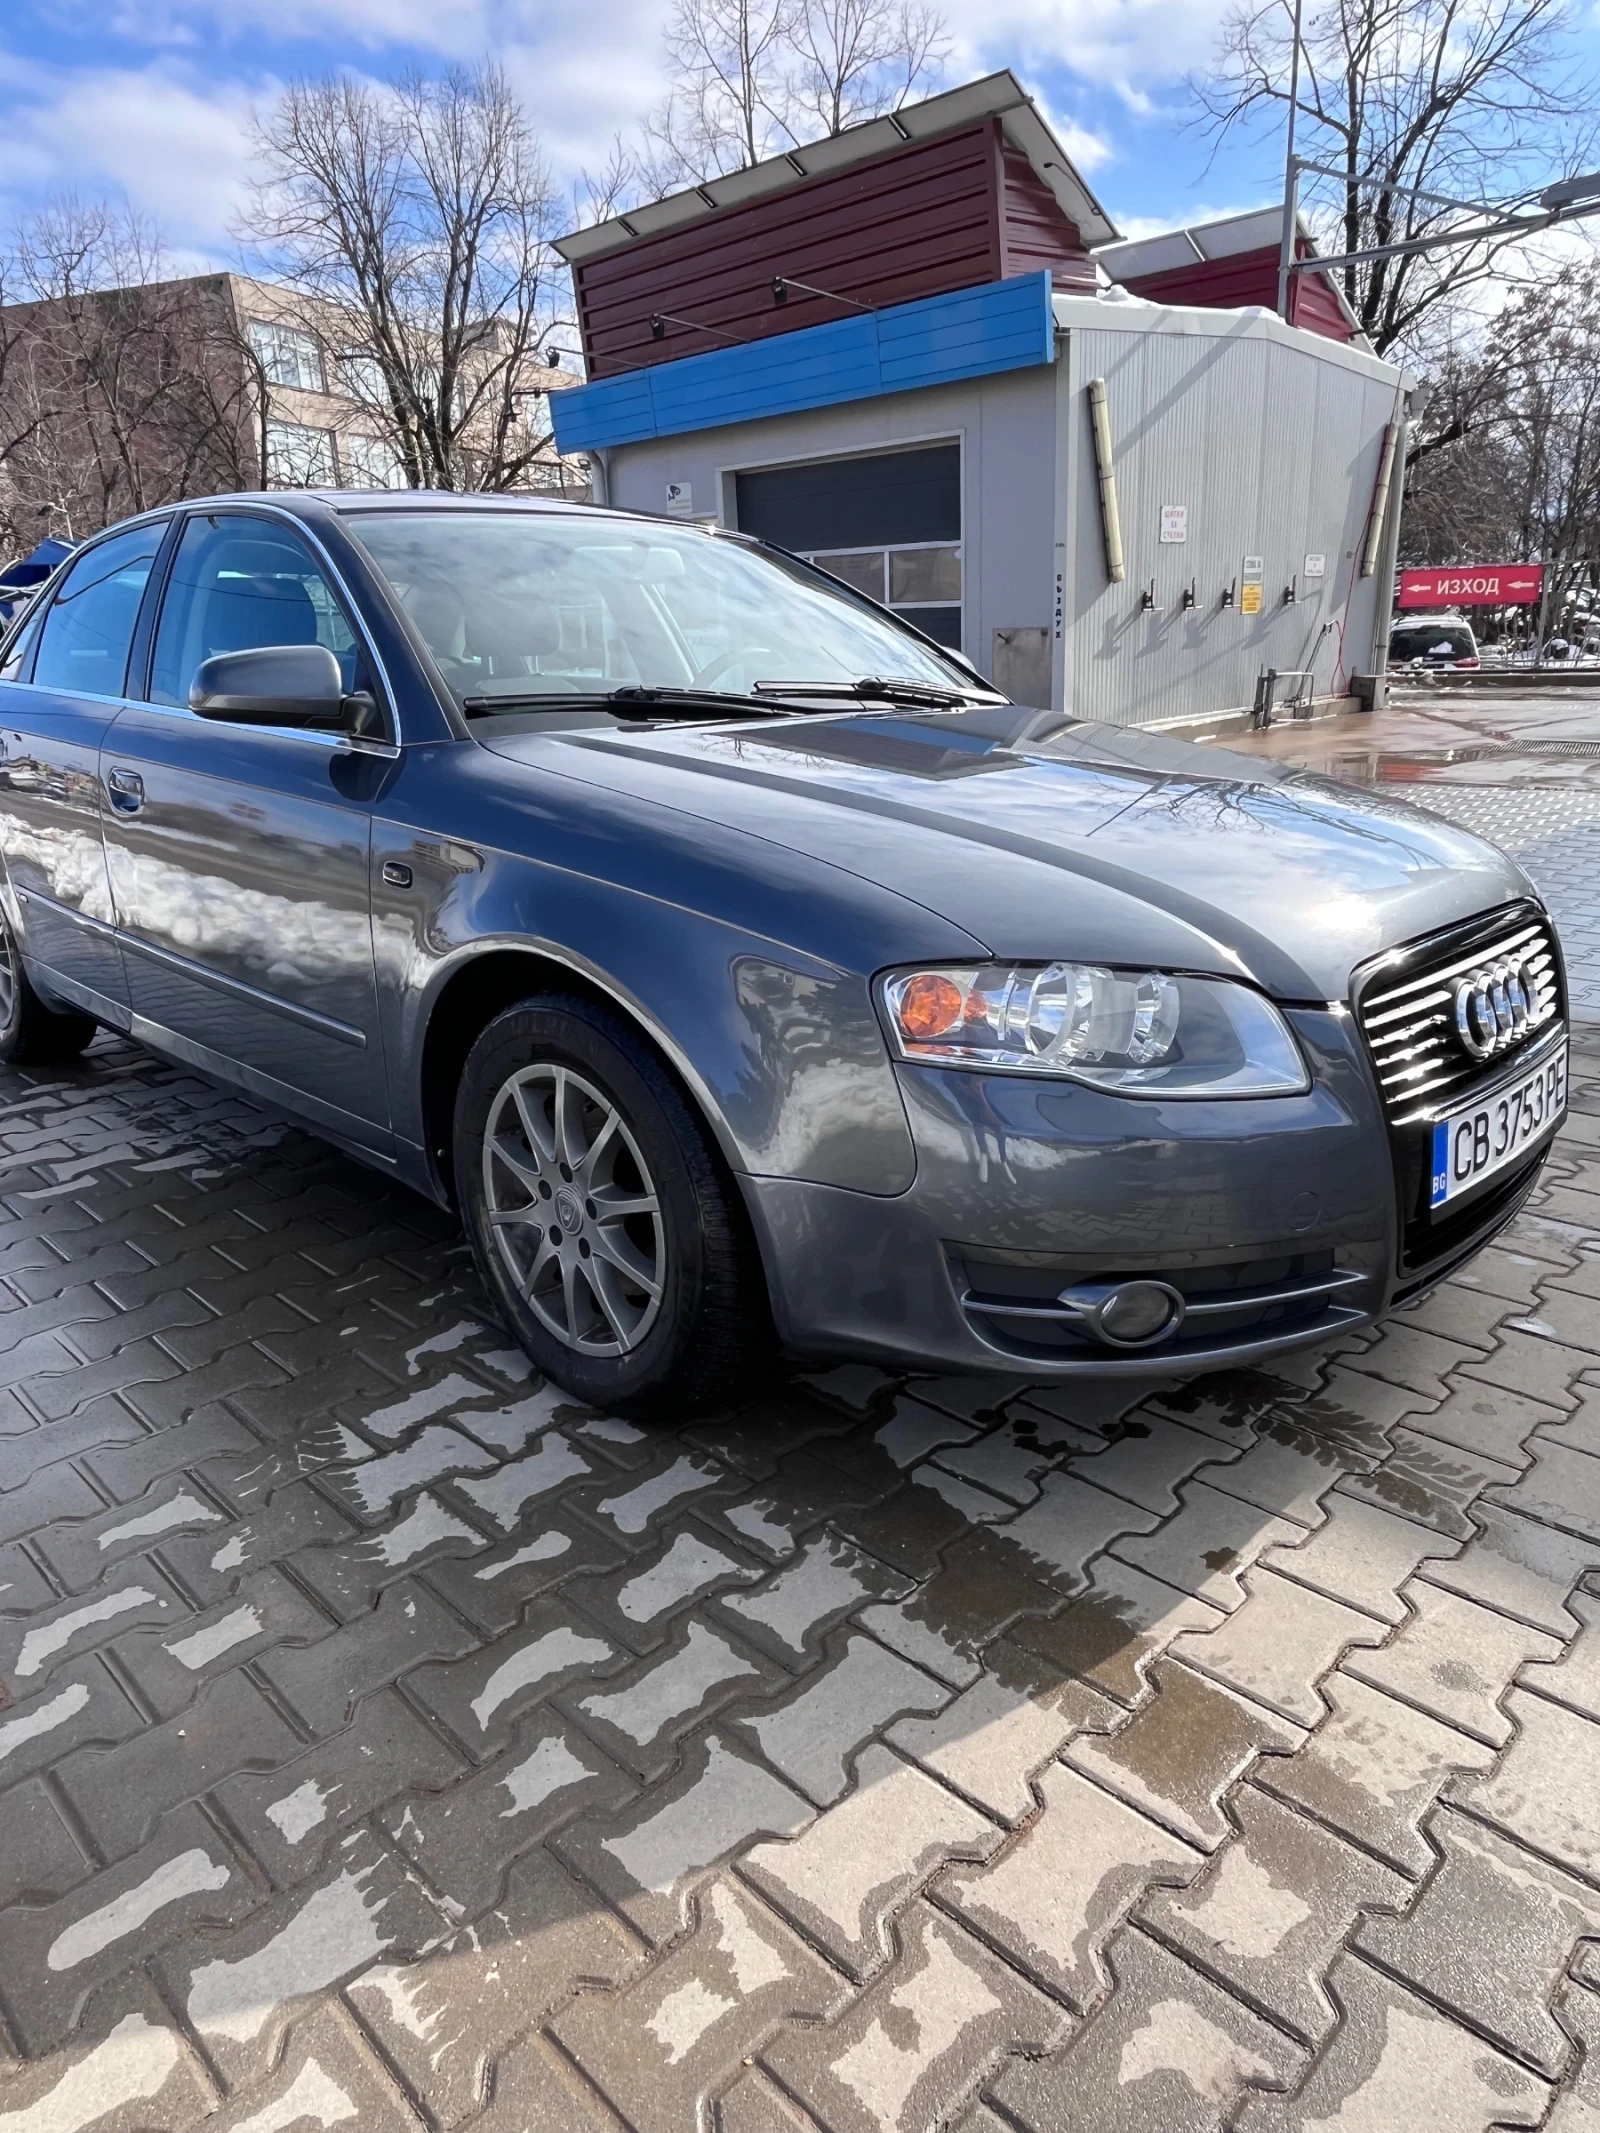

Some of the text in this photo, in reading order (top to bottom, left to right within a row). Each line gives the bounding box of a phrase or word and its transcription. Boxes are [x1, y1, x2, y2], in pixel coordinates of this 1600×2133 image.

[1436, 577, 1500, 596] ИЗХОД
[1453, 1111, 1490, 1182] CB
[1494, 1073, 1544, 1157] 3753
[1432, 1172, 1447, 1194] BG
